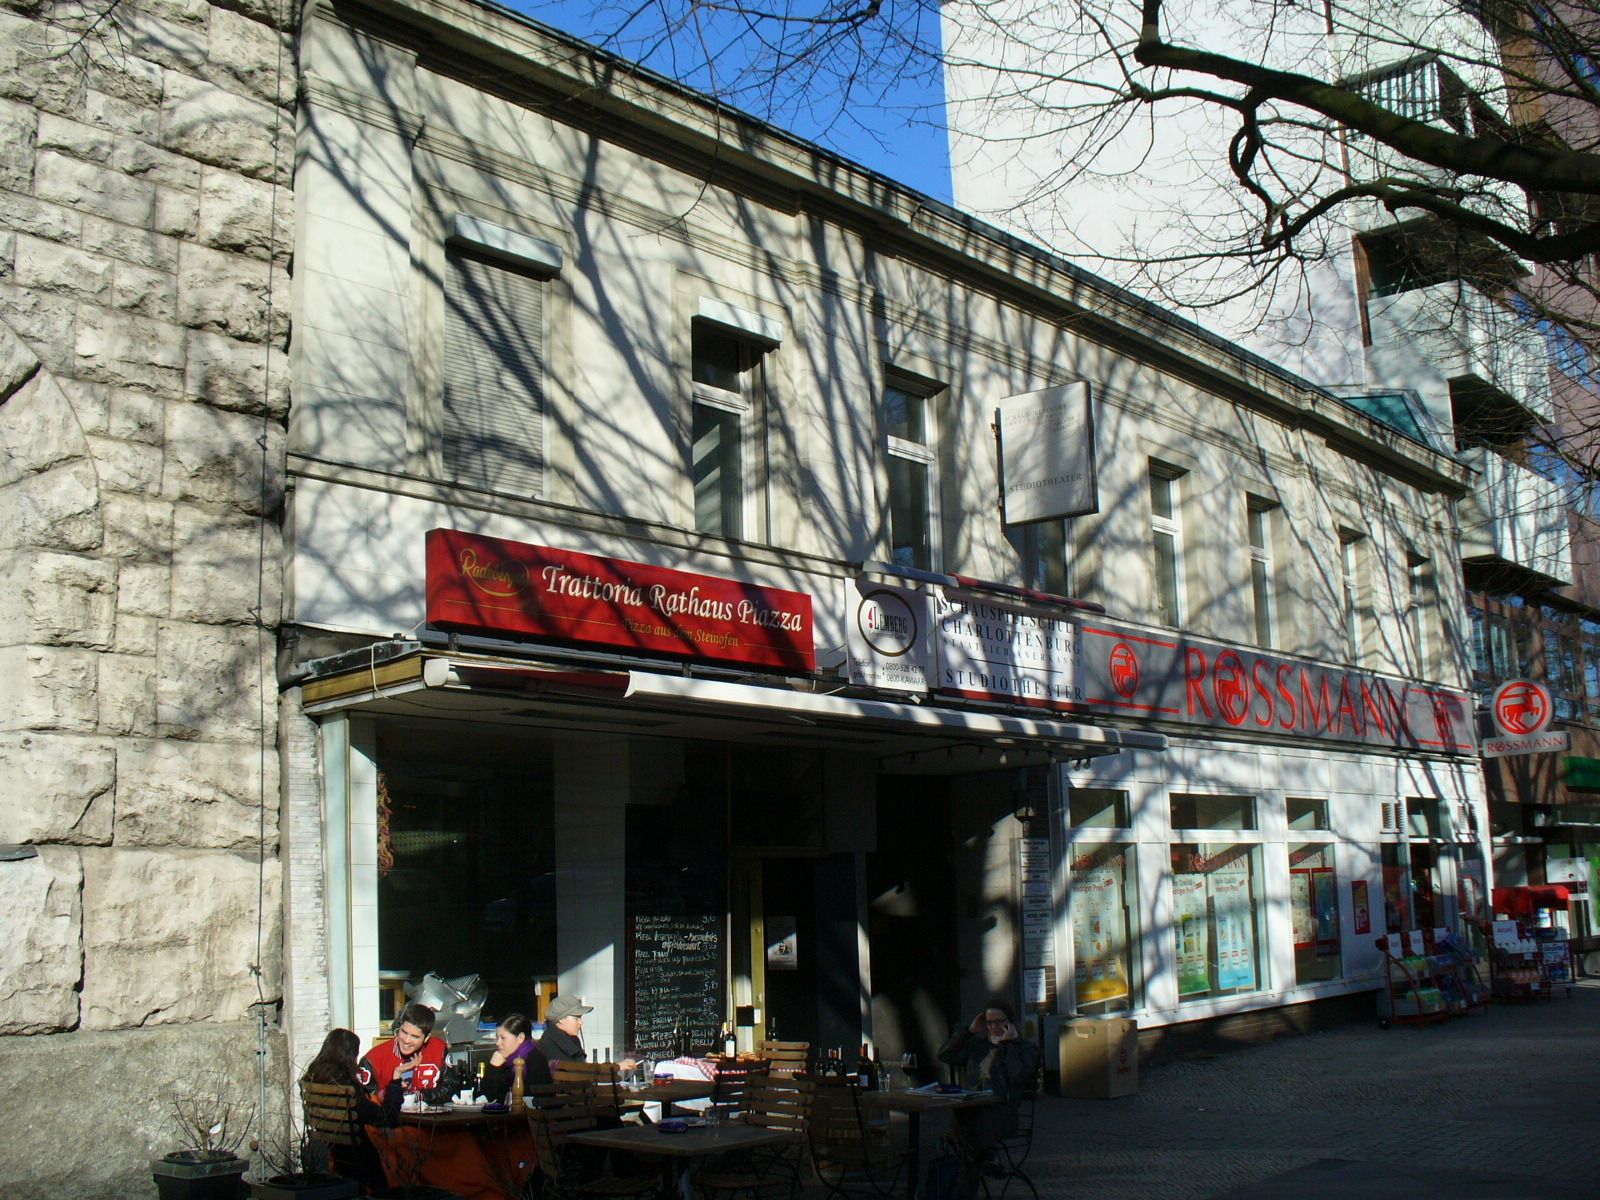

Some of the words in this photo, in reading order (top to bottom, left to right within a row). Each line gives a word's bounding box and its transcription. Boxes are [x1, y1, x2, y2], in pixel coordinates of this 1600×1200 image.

[1009, 473, 1083, 492] STUDIOTHEATER
[459, 548, 530, 597] Radeberg
[542, 565, 643, 608] Trattoria
[650, 585, 732, 621] Rathaus
[737, 599, 802, 632] Piazza
[873, 606, 908, 634] LEMBERG
[941, 597, 1079, 635] SCHAUSPIELSCHULE
[623, 617, 651, 634] Pizza
[654, 625, 671, 638] aus
[674, 625, 692, 640] dem
[694, 629, 739, 648] Steinofen
[942, 617, 1081, 655] CHARLOTTENBURG
[943, 637, 1009, 656] STAATLICH
[1016, 649, 1081, 667] ANERKANNT
[946, 668, 1082, 701] STUDIOTHEATER
[1184, 646, 1414, 742] ROSSMANN
[1487, 735, 1564, 753] ROSSMANN
[1186, 853, 1246, 873] ROSSANN
